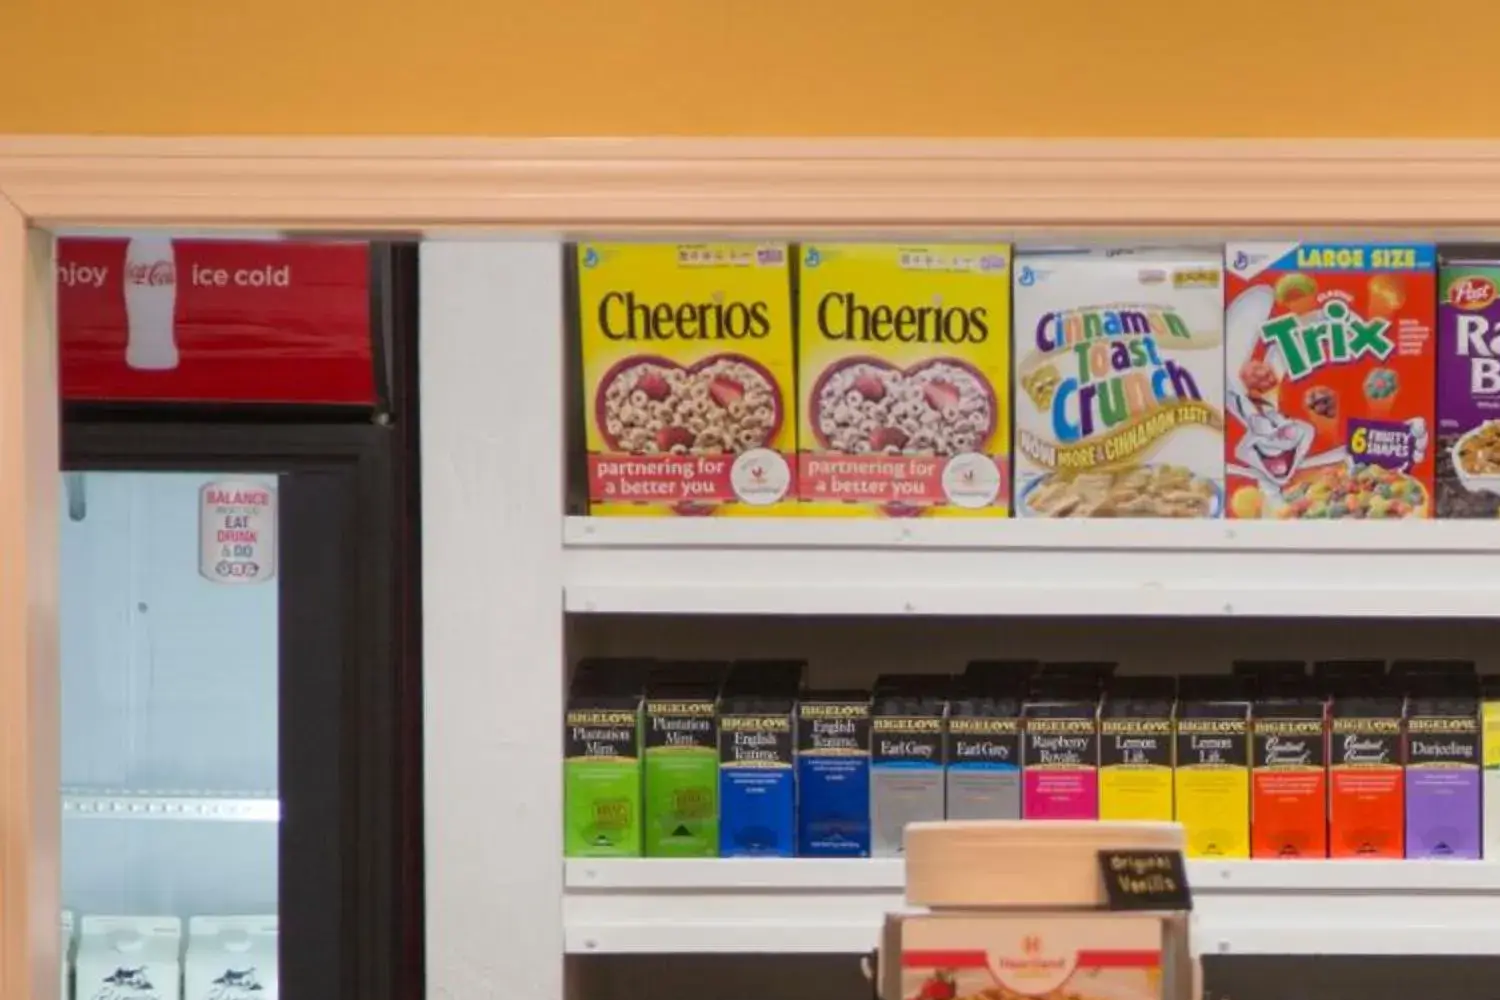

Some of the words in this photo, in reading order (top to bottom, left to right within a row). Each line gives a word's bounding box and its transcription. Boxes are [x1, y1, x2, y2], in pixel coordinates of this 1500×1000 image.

[1297, 249, 1364, 268] LARGE
[1371, 249, 1415, 268] SIZE
[192, 264, 229, 285] ice
[234, 265, 289, 286] cold
[1455, 281, 1490, 303] Post
[599, 291, 771, 341] Cheerios
[817, 291, 989, 344] Cheerios
[1036, 310, 1191, 352] Cinnamon
[1261, 300, 1396, 381] Trix
[1074, 336, 1163, 385] Toast
[1052, 359, 1202, 444] Crunch
[1104, 411, 1175, 461] CINNAMON
[1351, 426, 1368, 454] 6
[597, 460, 695, 479] partnering
[699, 458, 725, 474] for
[809, 460, 905, 478] partnering
[909, 460, 936, 476] for
[605, 482, 616, 494] a
[621, 478, 676, 494] better
[681, 481, 715, 497] you
[816, 480, 826, 492] a
[831, 476, 885, 493] better
[892, 480, 926, 496] you
[207, 491, 268, 505] BALANCE
[225, 515, 250, 528] EAT
[217, 530, 258, 543] DRINK
[648, 703, 714, 713] BIGELOW
[801, 705, 869, 715] BIGELOW
[567, 713, 635, 724] BIGELOW
[653, 717, 709, 731] Plantation
[721, 718, 788, 728] BIGELOW
[873, 719, 940, 729] BIGELOW
[950, 720, 1016, 729] BIGELOW
[1333, 720, 1398, 729] BIGELOW
[1408, 719, 1476, 728] BIGELOW
[813, 720, 856, 734] English
[1027, 722, 1094, 731] BIGELOW
[1103, 722, 1170, 731] BIGELOW
[1178, 722, 1246, 731] BIGELOW
[1255, 722, 1322, 731] BIGELOW
[735, 732, 776, 746] English
[1032, 736, 1089, 750] Raspberry
[1116, 735, 1157, 749] Lemon
[1191, 735, 1232, 749] Lemon
[881, 740, 904, 755] Earl
[957, 741, 980, 755] Earl
[1412, 741, 1473, 757] Darjeeling
[1111, 854, 1171, 874] Original
[1117, 873, 1177, 894] Vanilla
